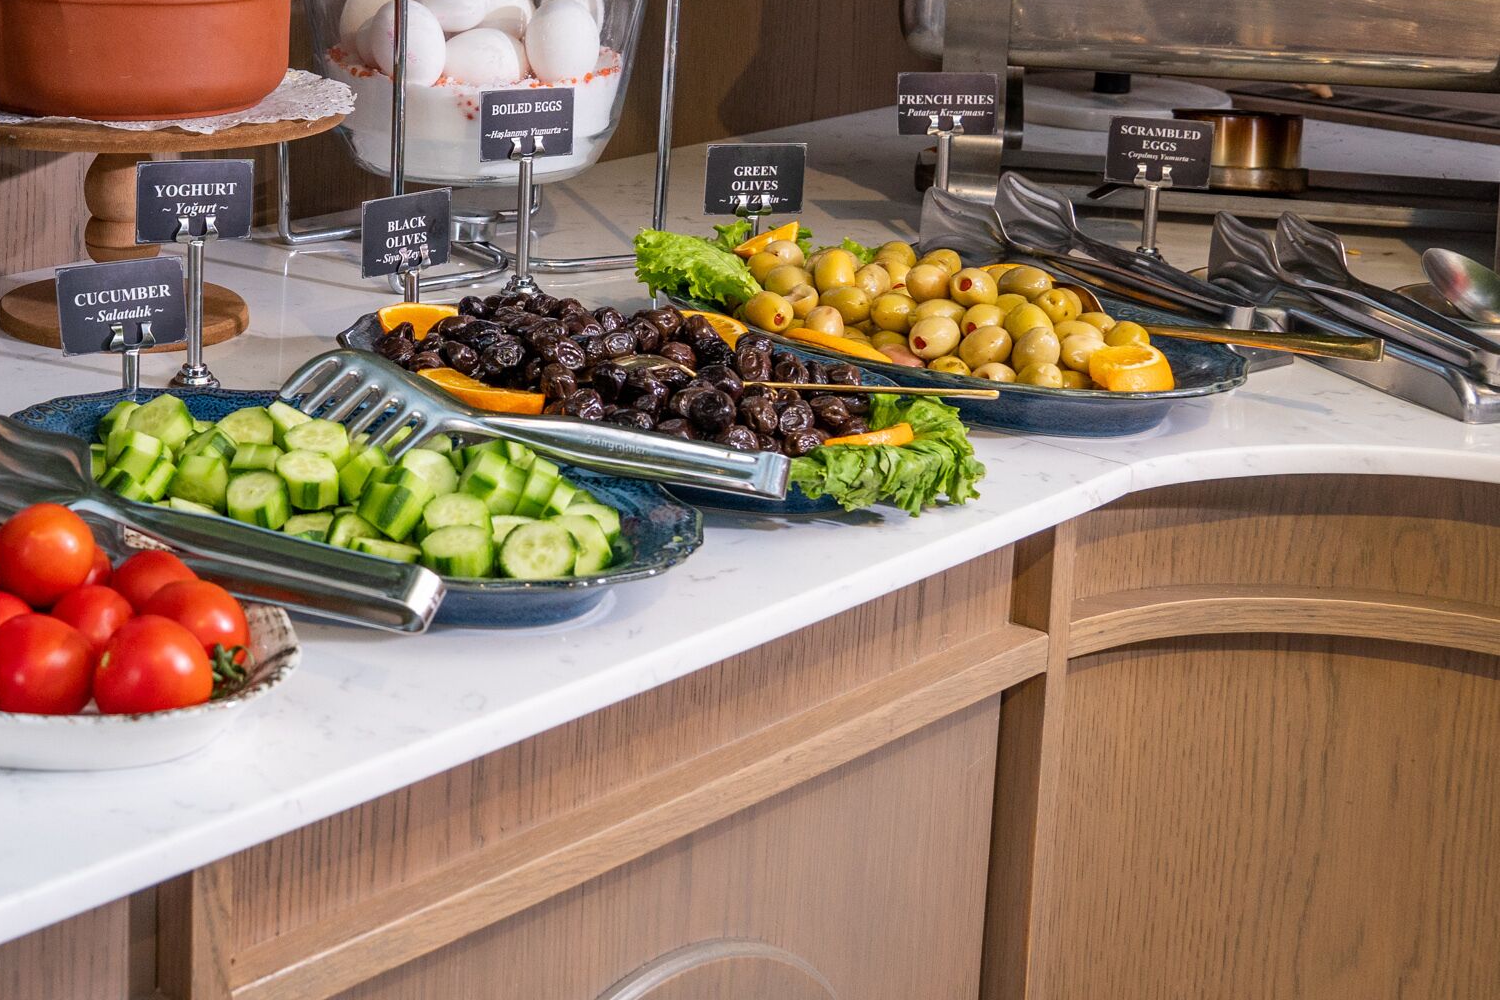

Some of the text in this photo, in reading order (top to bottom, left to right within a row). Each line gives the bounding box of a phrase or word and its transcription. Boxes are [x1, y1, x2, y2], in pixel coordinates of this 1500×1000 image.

[898, 94, 994, 105] FRENCH FRIES
[491, 100, 563, 116] BOILED EGGS
[530, 126, 562, 136] Yumurta
[1120, 124, 1202, 141] SCRAMBLED
[1142, 140, 1177, 152] EGGS
[1160, 153, 1190, 162] Yumurta
[733, 165, 779, 177] GREEN
[154, 182, 238, 198] YOGHURT
[731, 180, 779, 191] OLIVES
[175, 202, 217, 216] Yoğurt
[387, 215, 427, 233] BLACK
[385, 231, 428, 249] OLIVES
[382, 252, 402, 265] Siya
[74, 284, 172, 307] CUCUMBER
[96, 305, 152, 323] Salatalık
